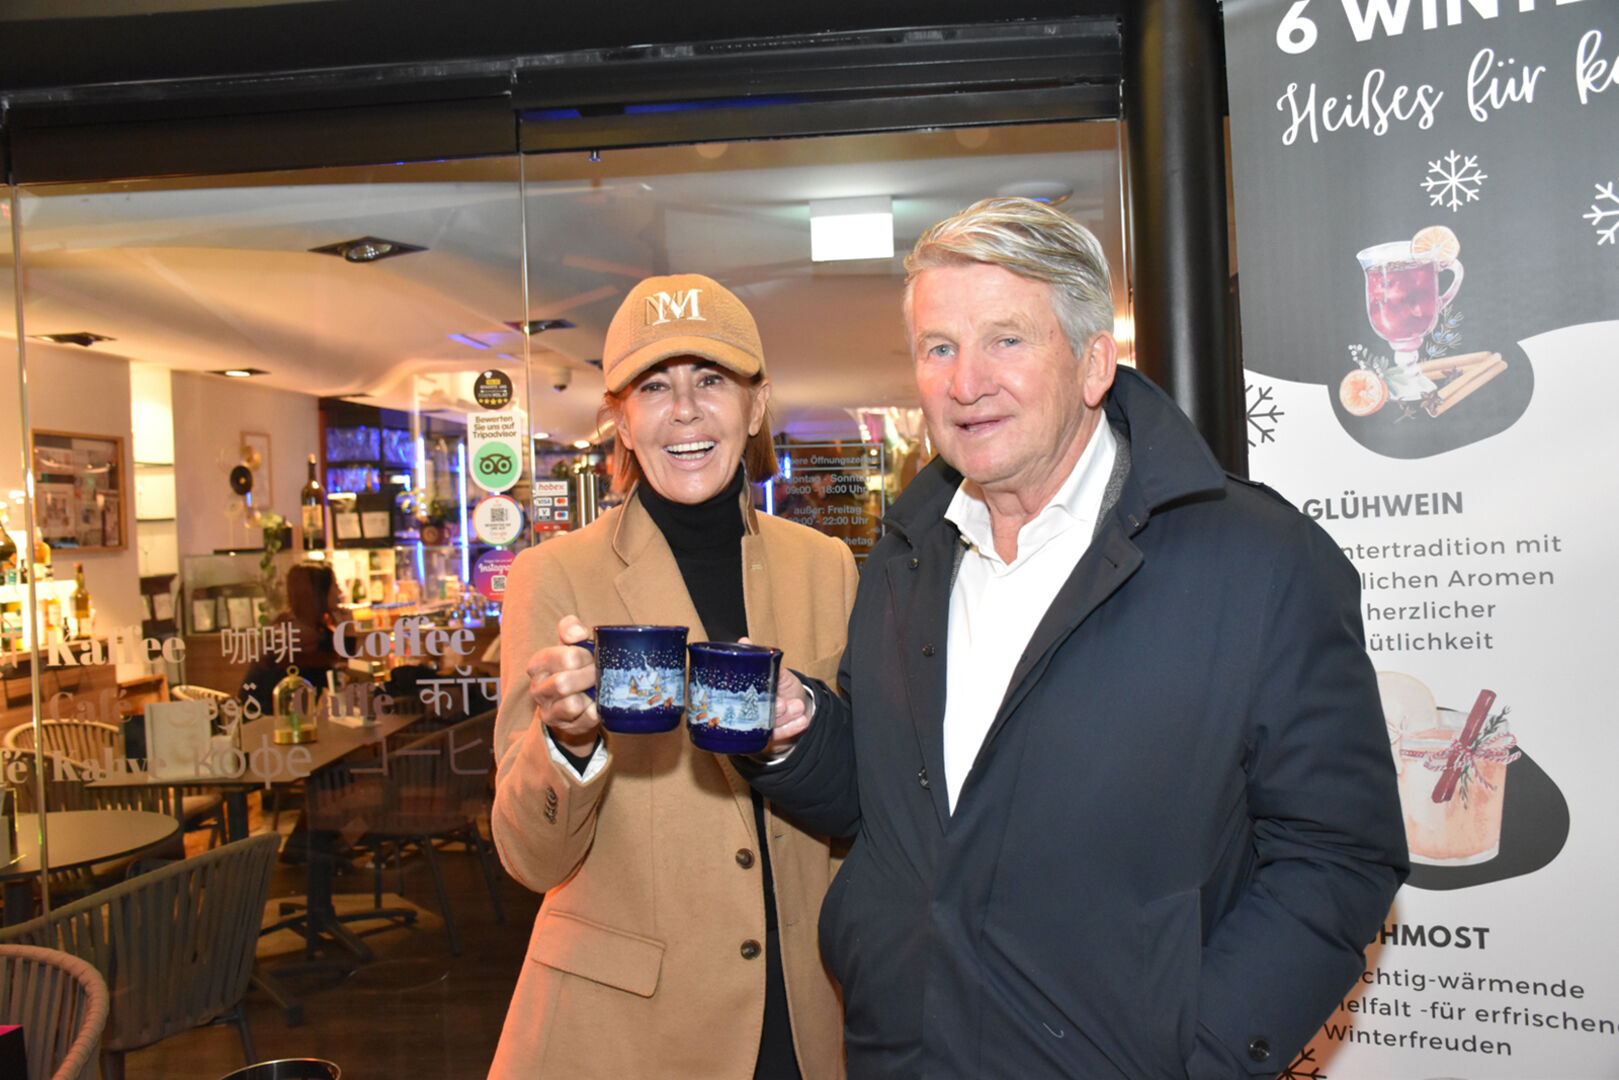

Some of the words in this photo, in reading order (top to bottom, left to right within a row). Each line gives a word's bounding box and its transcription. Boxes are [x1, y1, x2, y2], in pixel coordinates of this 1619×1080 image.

[1276, 0, 1318, 54] 6
[1276, 69, 1444, 146] Heißes
[1467, 48, 1546, 122] für
[1576, 29, 1619, 104] k
[472, 430, 517, 439] Tripadvisor
[474, 423, 485, 431] Sie
[501, 421, 515, 430] auf
[475, 416, 513, 424] Bewerten
[821, 485, 847, 494] 18:00
[848, 485, 868, 494] Uhr
[827, 504, 862, 515] Freitag
[1302, 490, 1464, 521] GLÜHWEIN
[822, 517, 849, 526] 22:00
[850, 516, 869, 525] Uhr
[1341, 537, 1505, 561] ntertradition
[1516, 534, 1562, 554] mit
[1361, 571, 1439, 590] lichen
[1447, 569, 1555, 588] Aromen
[1366, 601, 1496, 621] herzlicher
[46, 624, 188, 667] Kaffee
[220, 621, 303, 665] 咖啡
[333, 615, 476, 660] Coffee
[1369, 631, 1494, 652] ütlichkeit
[50, 688, 134, 724] Café
[52, 746, 168, 784] Kahve
[194, 734, 313, 791] кофе
[349, 730, 495, 776] コーヒ
[1370, 923, 1490, 950] HMOST
[1361, 967, 1585, 999] chtig-wärmende
[1474, 1008, 1619, 1034] erfrischen
[1323, 1022, 1513, 1057] Winterfreuden
